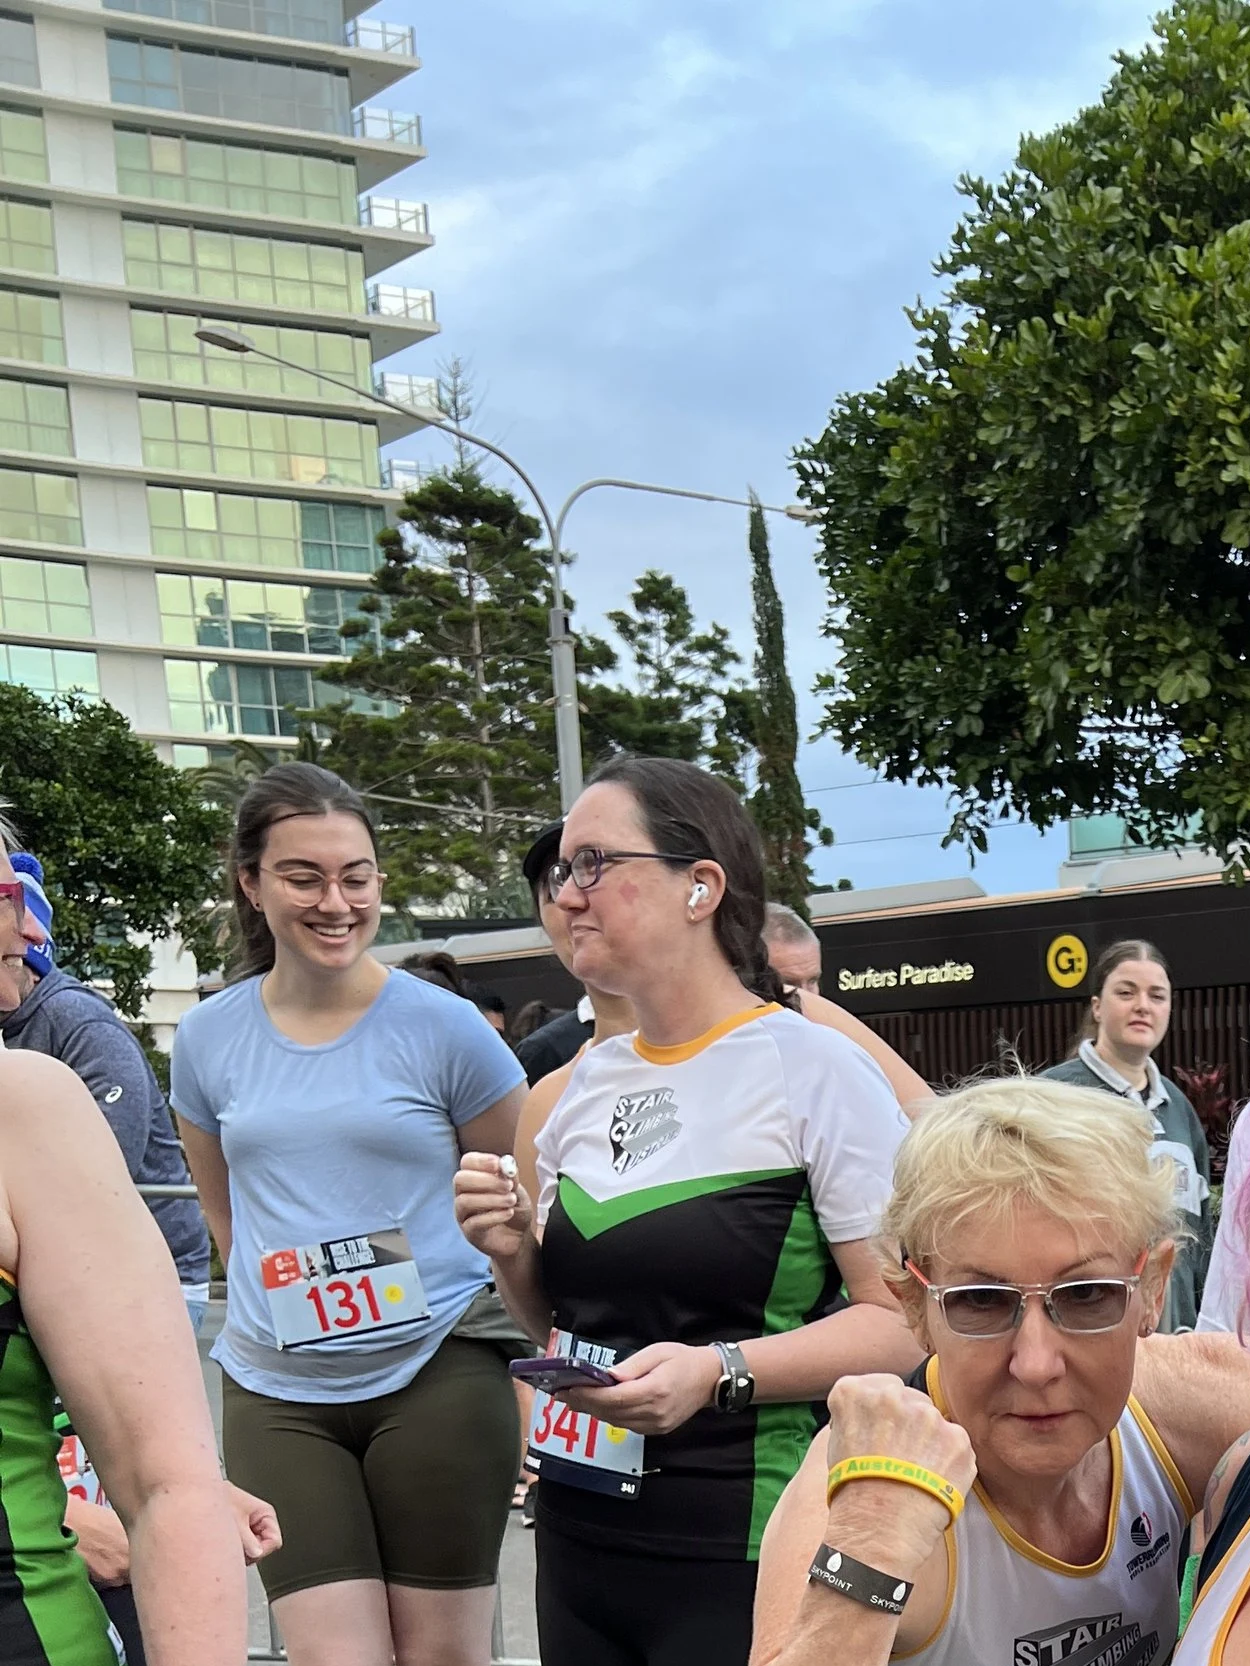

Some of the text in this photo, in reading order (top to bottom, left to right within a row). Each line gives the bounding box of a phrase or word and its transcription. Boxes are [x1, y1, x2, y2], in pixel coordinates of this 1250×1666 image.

[838, 960, 974, 991] Surfers Paradise
[614, 1090, 673, 1118] STAIR
[306, 1275, 381, 1332] 131
[534, 1396, 600, 1459] 341
[846, 1460, 940, 1490] Australia
[811, 1564, 853, 1592] SKYPOINT
